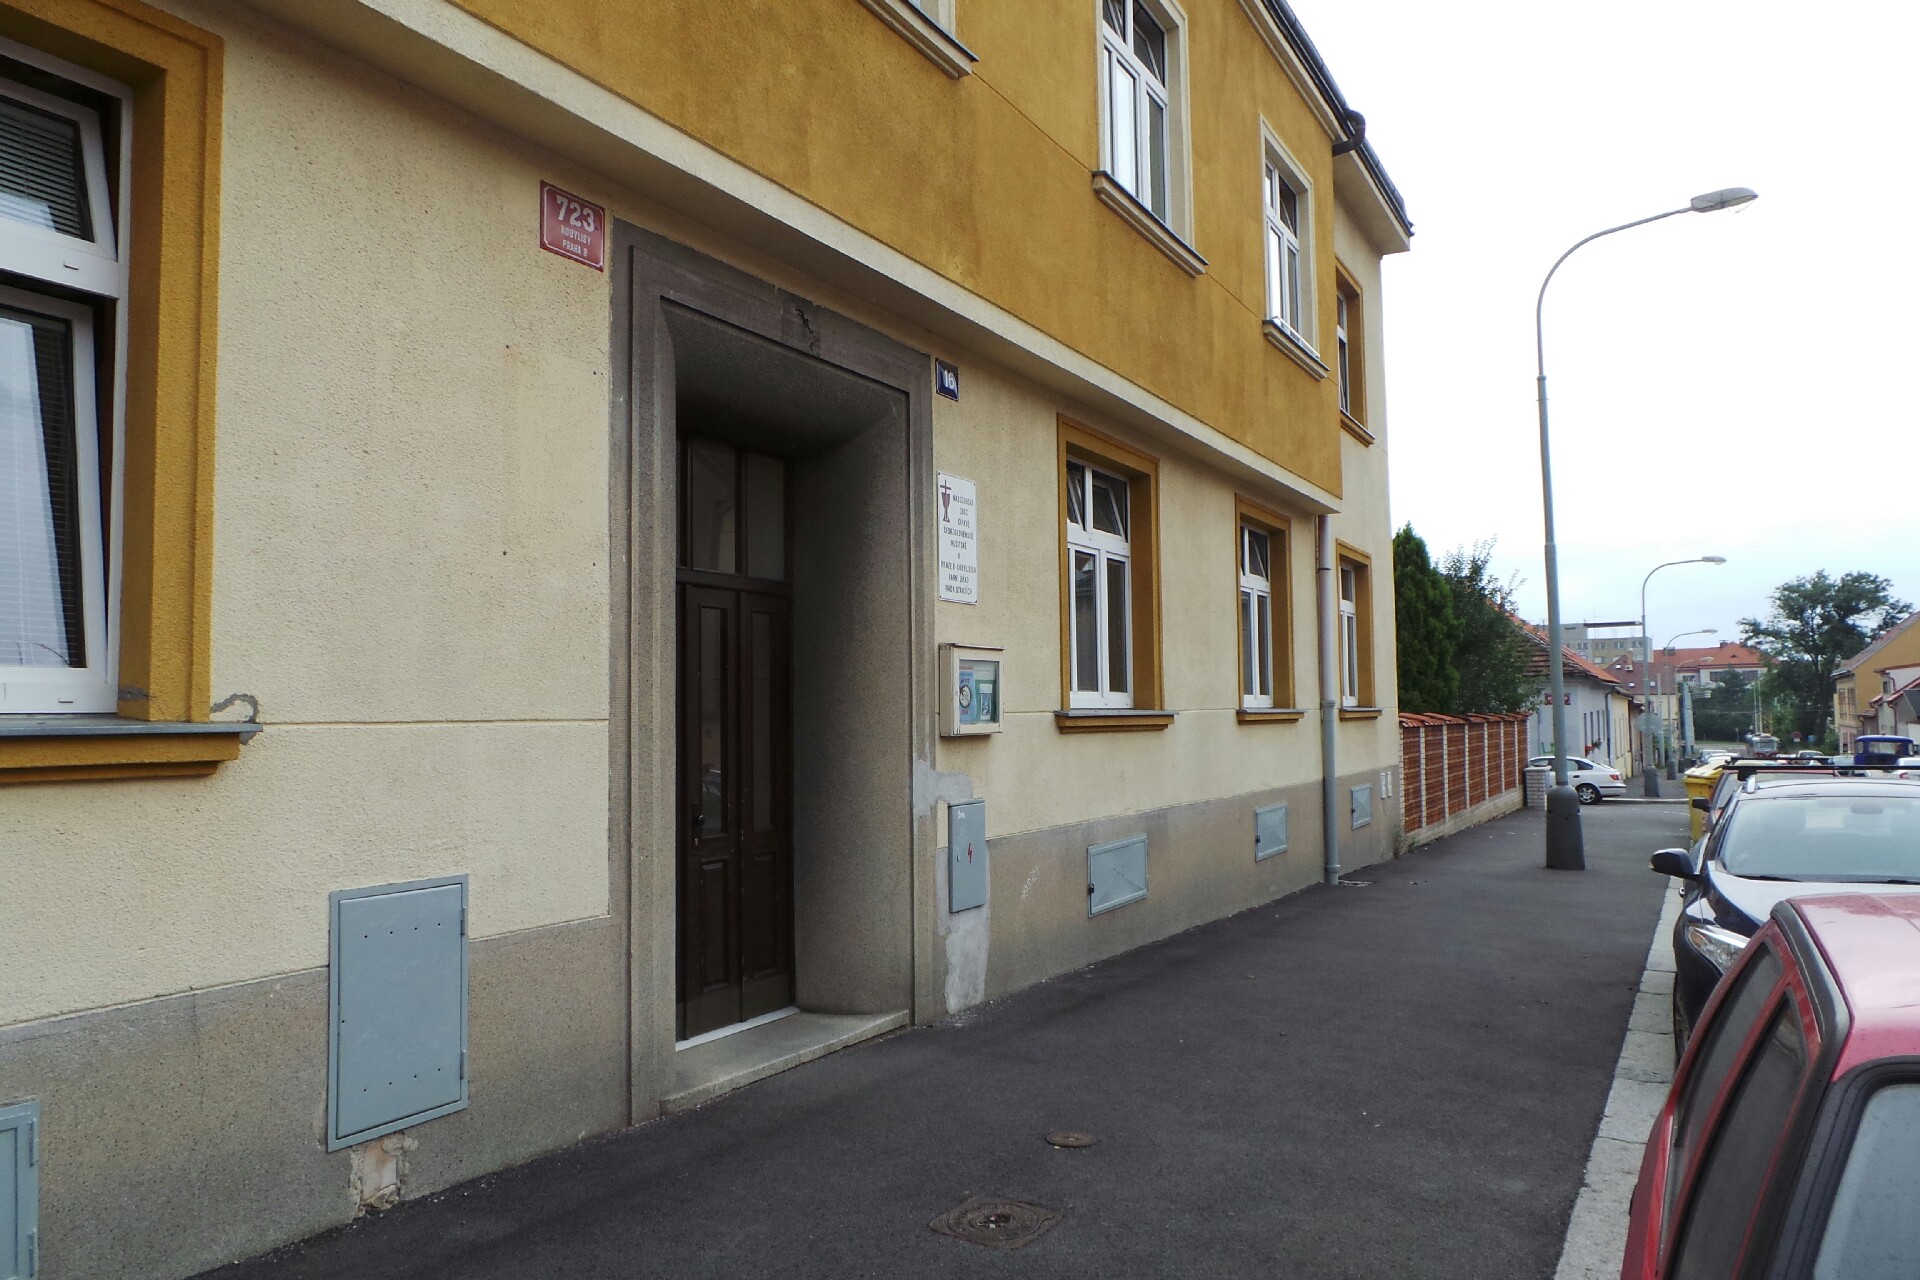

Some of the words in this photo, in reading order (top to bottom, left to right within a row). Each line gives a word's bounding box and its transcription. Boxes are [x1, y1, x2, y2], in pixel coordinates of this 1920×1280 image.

[556, 194, 595, 233] 723
[562, 239, 582, 255] PRAHA
[945, 370, 955, 389] 16
